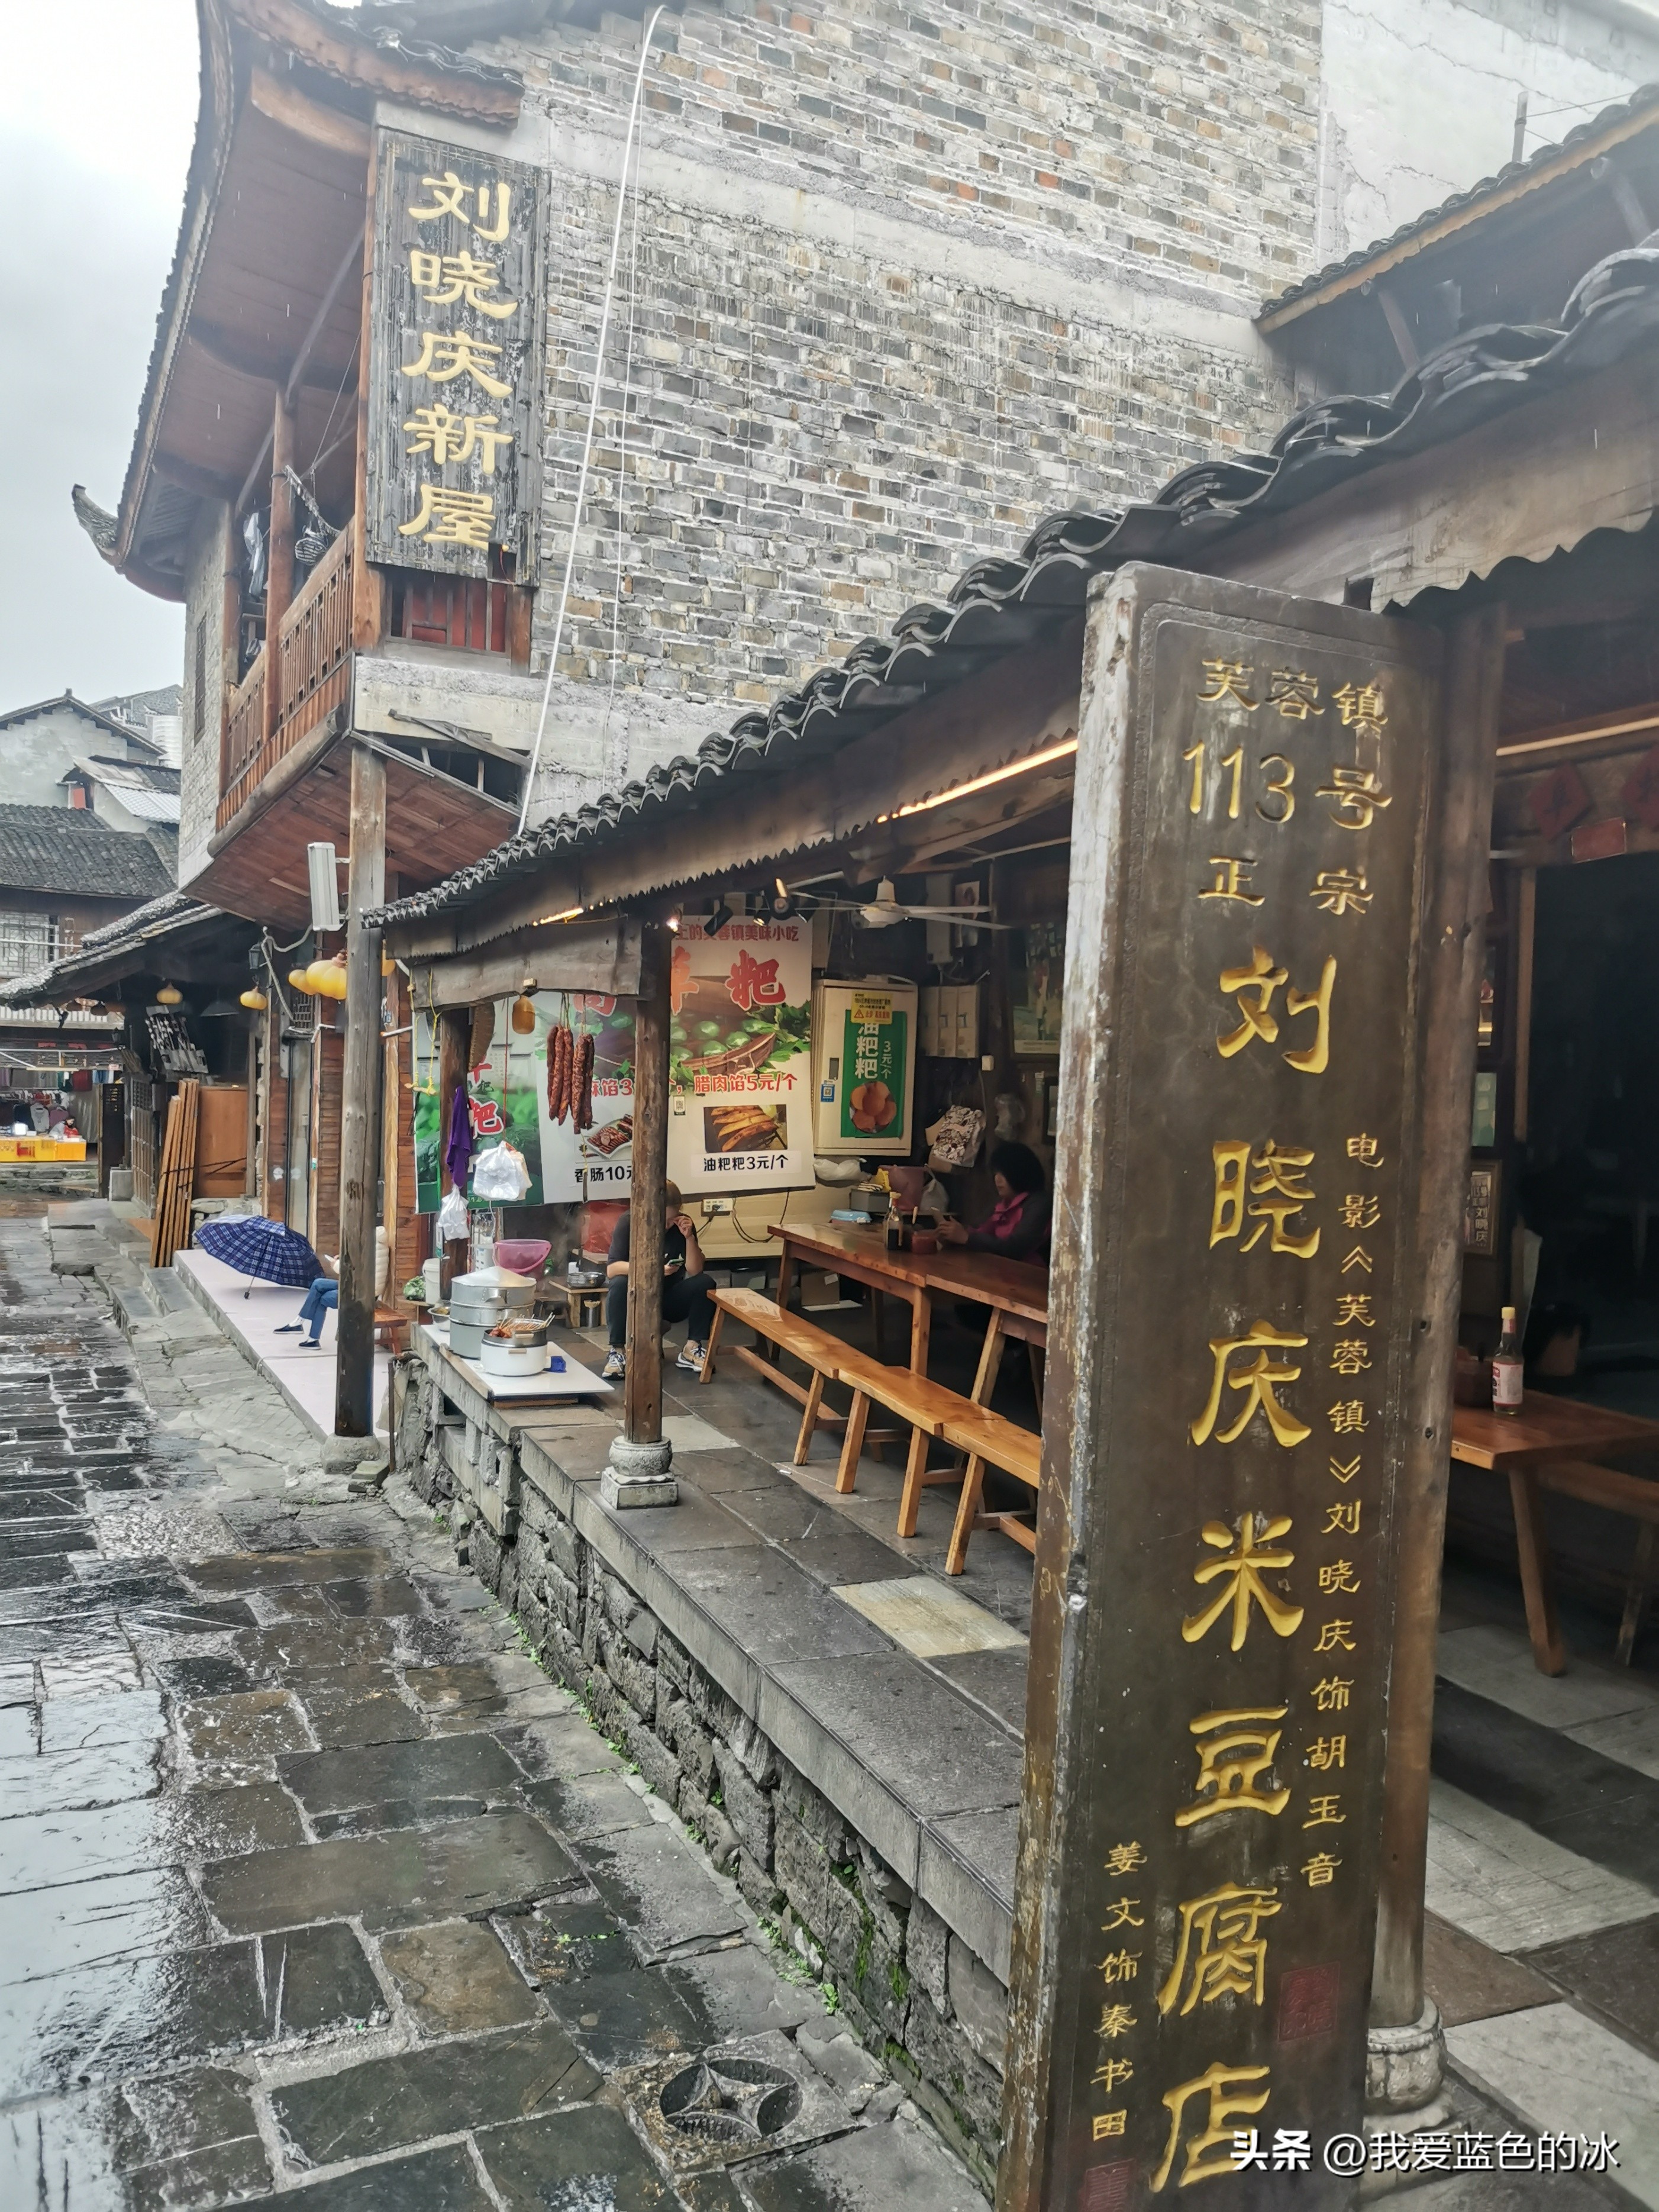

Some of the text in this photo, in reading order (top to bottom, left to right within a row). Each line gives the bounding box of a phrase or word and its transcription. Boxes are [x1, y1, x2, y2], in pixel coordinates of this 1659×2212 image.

[398, 172, 518, 550] 刘晓庆新屋
[1196, 656, 1388, 734] 芙蓉镇
[1183, 740, 1393, 830] 113号
[1197, 856, 1374, 915] 正宗
[881, 1040, 893, 1079] 3元/个
[703, 1154, 789, 1172] 油粑粑3元/个
[1301, 1132, 1384, 1888] 电影《芙蓉镇》刘晓庆饰胡玉音
[1149, 945, 1337, 2192] 刘晓庆米豆腐店
[1090, 1842, 1147, 2141] 姜文饰秦书田
